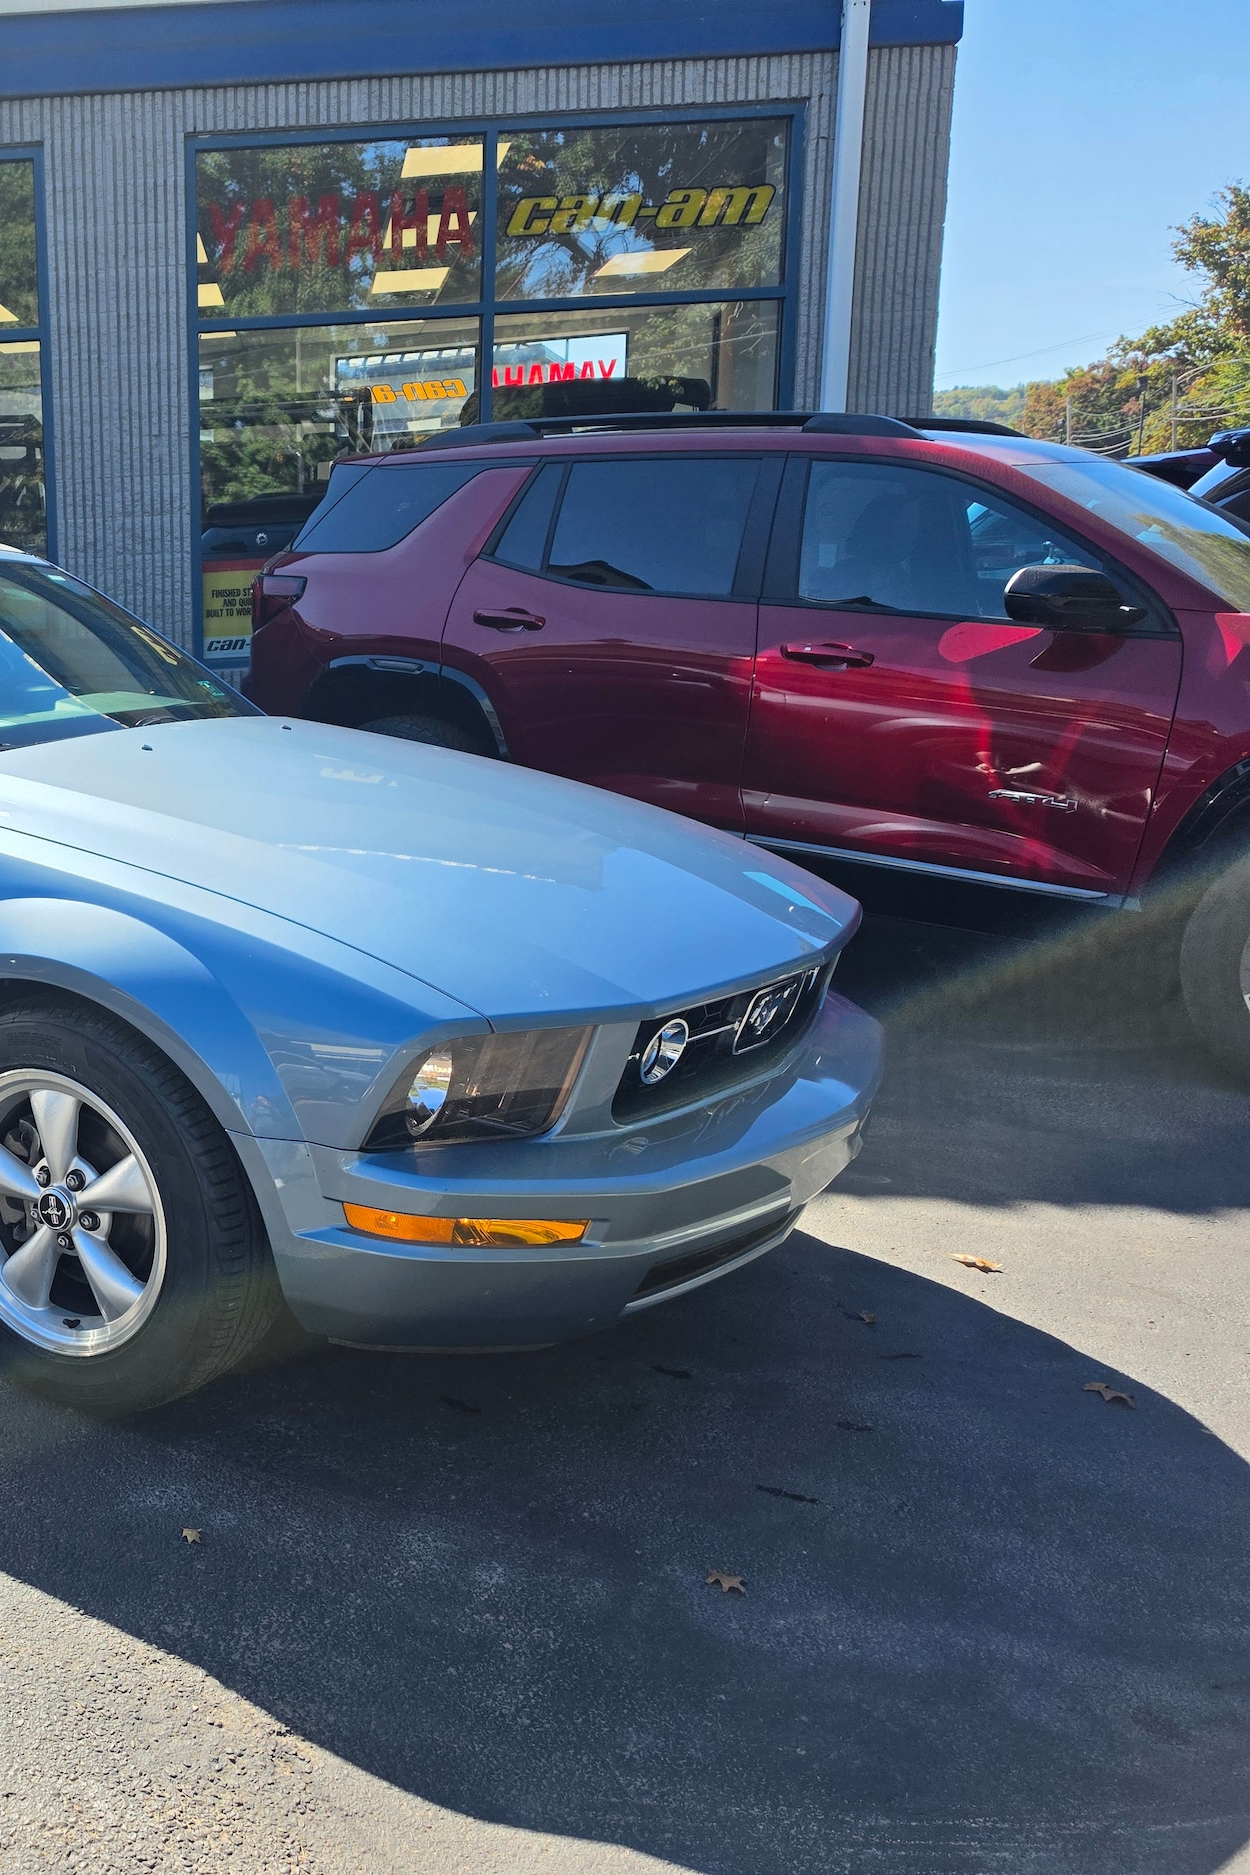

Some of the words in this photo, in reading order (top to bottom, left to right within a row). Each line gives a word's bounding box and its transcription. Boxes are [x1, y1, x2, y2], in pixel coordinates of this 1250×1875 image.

[506, 184, 776, 237] can-am
[208, 186, 474, 274] YAMAHA
[211, 588, 241, 599] FINISHED
[223, 598, 237, 608] AND
[206, 608, 224, 619] BUILT
[225, 608, 235, 617] TO
